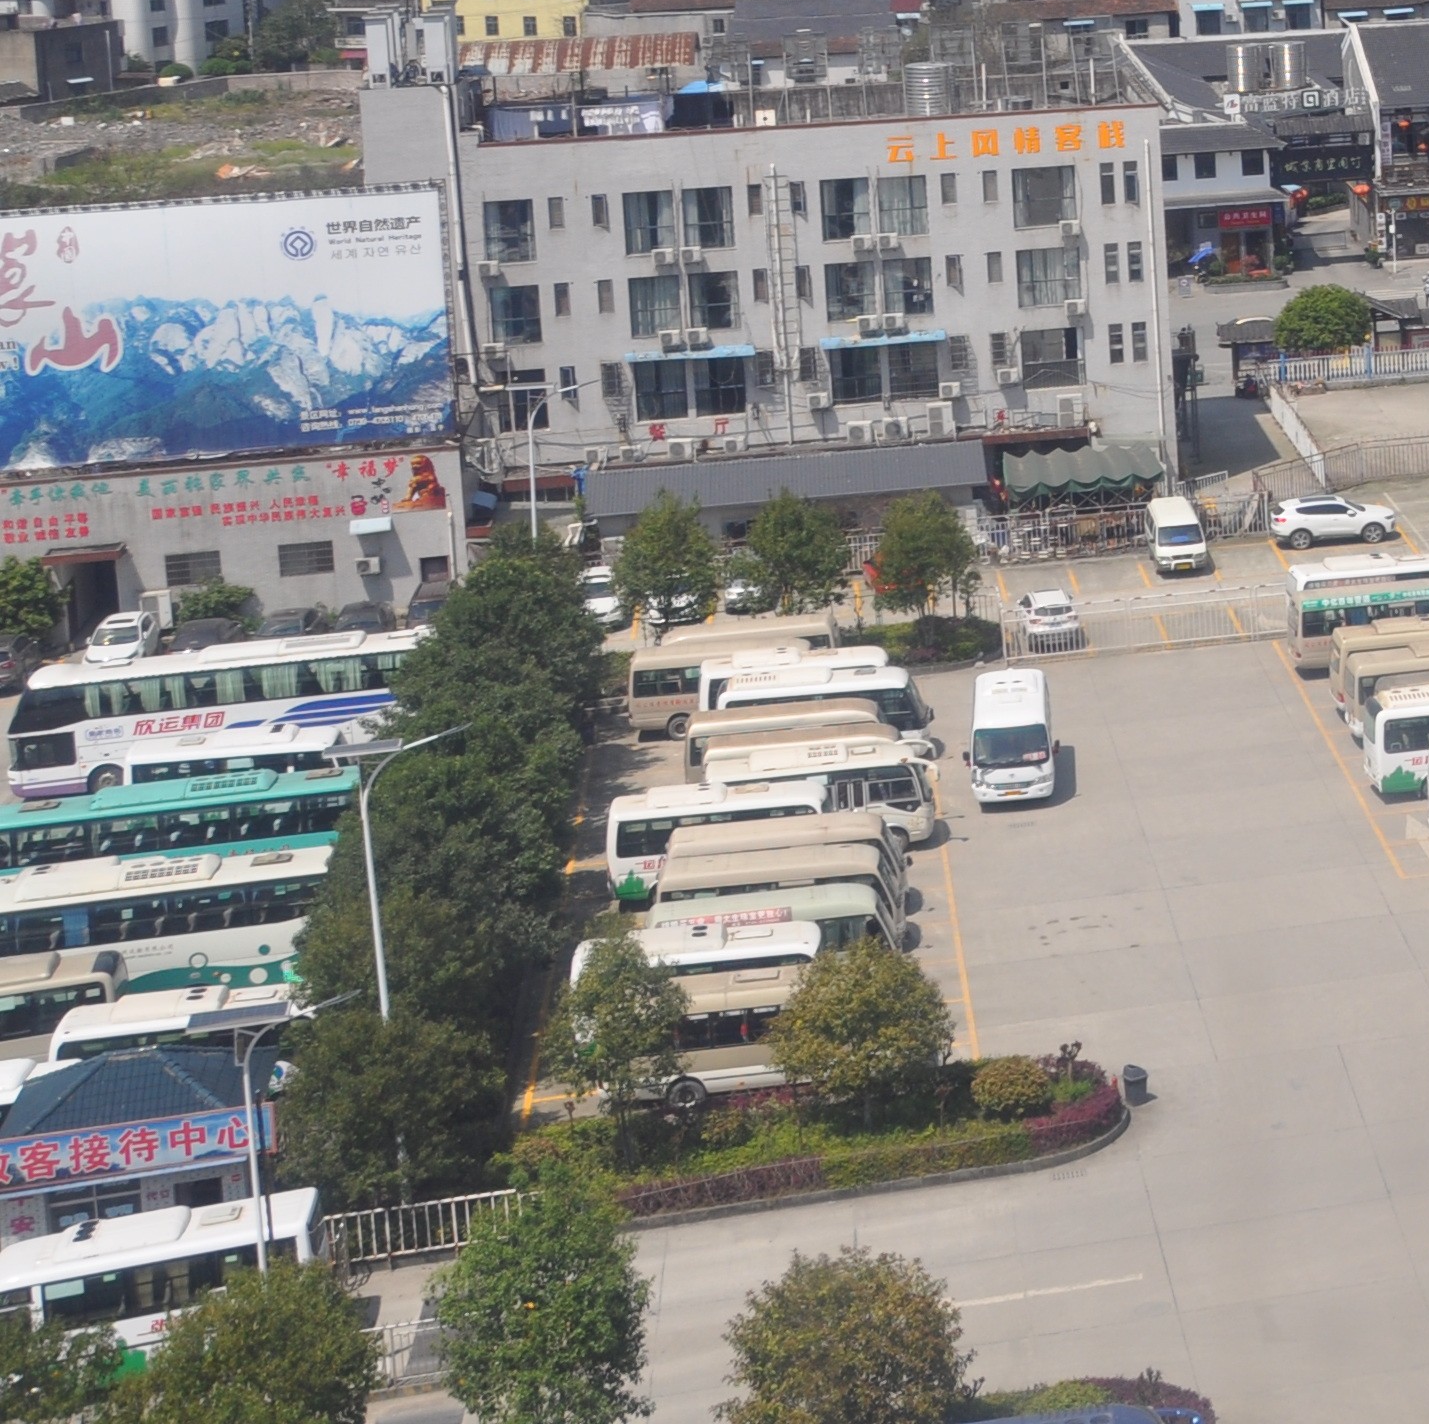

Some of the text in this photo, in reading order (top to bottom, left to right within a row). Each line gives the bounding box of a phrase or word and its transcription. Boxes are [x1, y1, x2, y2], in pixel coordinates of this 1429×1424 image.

[886, 121, 1126, 163] 云上风情客栈
[326, 216, 421, 235] 世界自然遗产
[132, 711, 226, 736] 欣运集团
